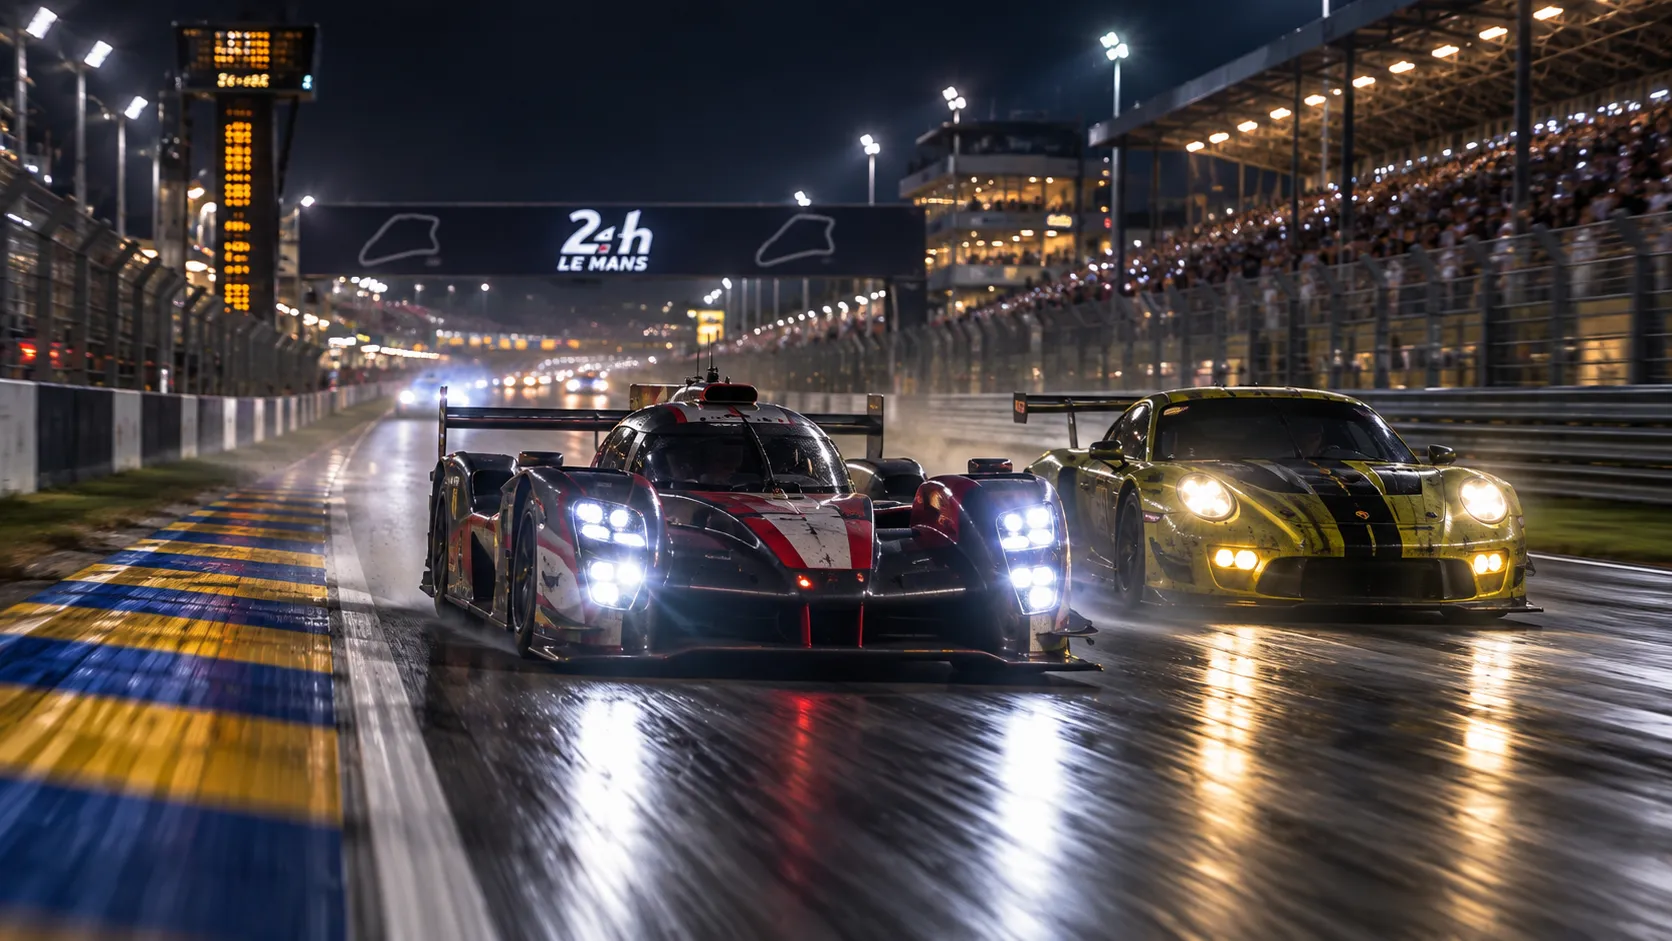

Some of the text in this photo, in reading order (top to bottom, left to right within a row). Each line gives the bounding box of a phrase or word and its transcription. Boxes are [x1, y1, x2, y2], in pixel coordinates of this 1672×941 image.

[561, 209, 652, 254] 24h
[557, 256, 648, 271] LE MANS
